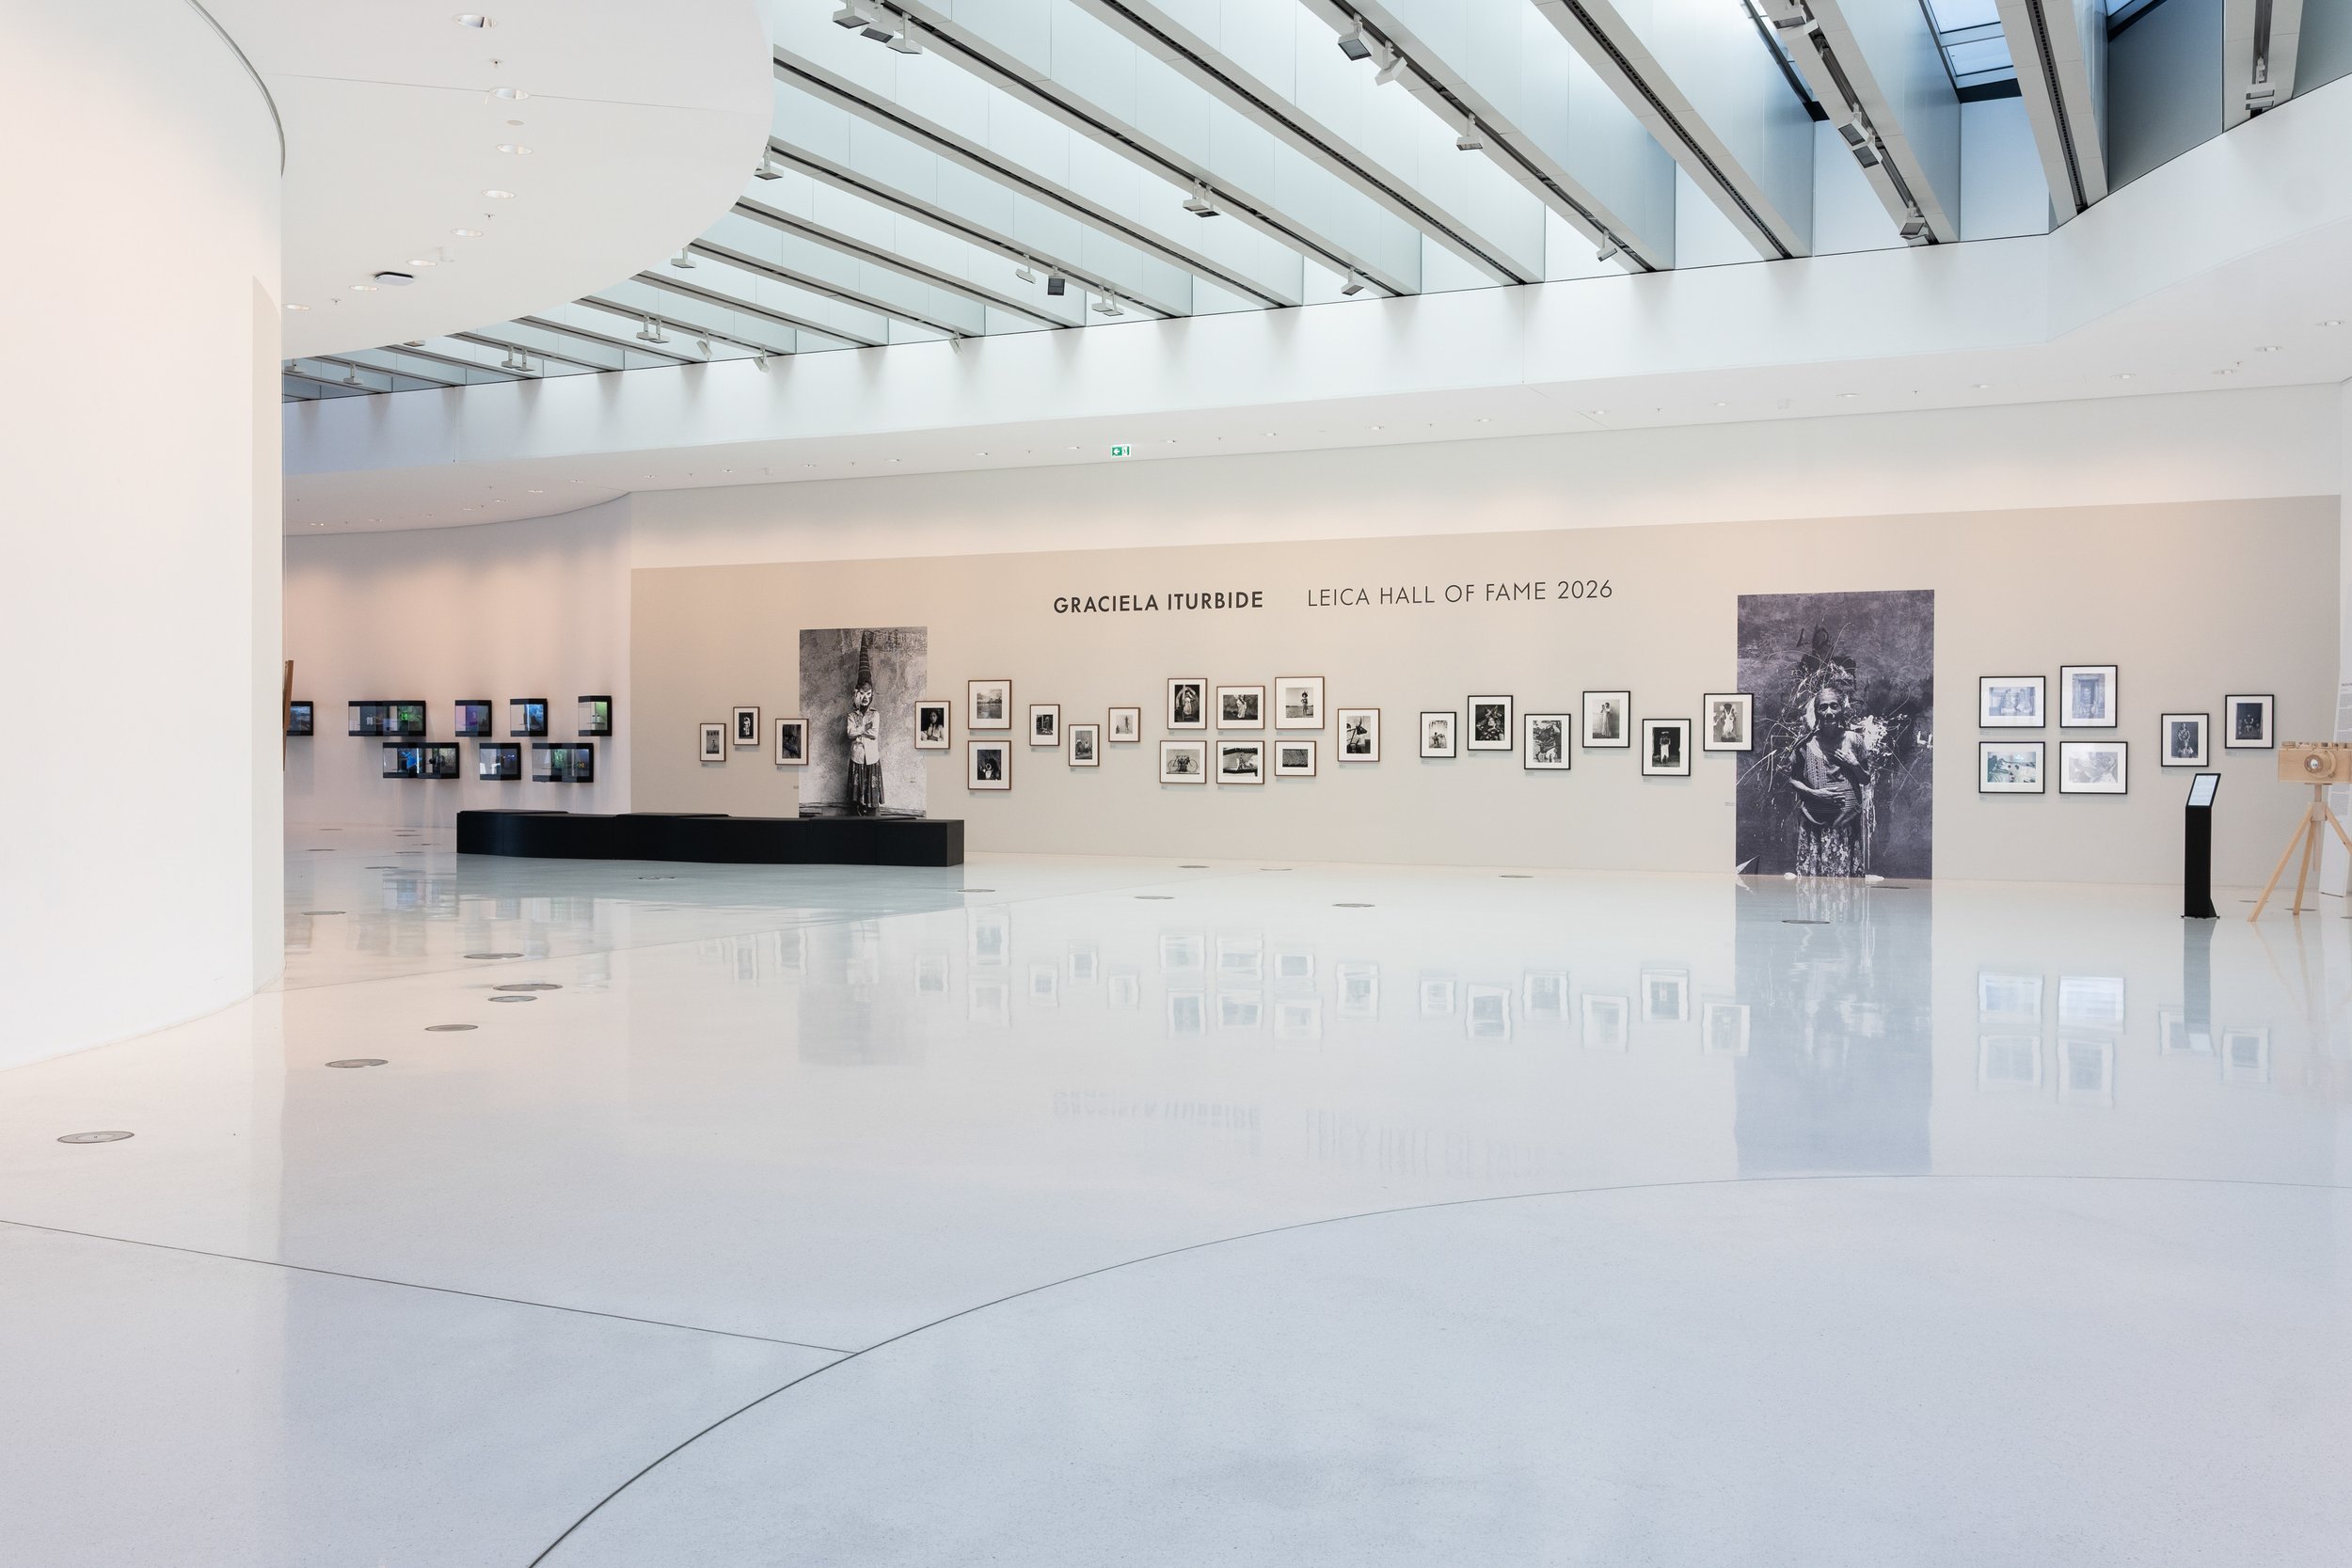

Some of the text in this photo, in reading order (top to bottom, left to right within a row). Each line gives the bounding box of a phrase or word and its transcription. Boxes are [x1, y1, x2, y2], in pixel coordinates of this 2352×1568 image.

[1054, 592, 1263, 614] GRACIELA ITURBIDE
[1308, 579, 1613, 607] LEICA HALL OF FAME 2026
